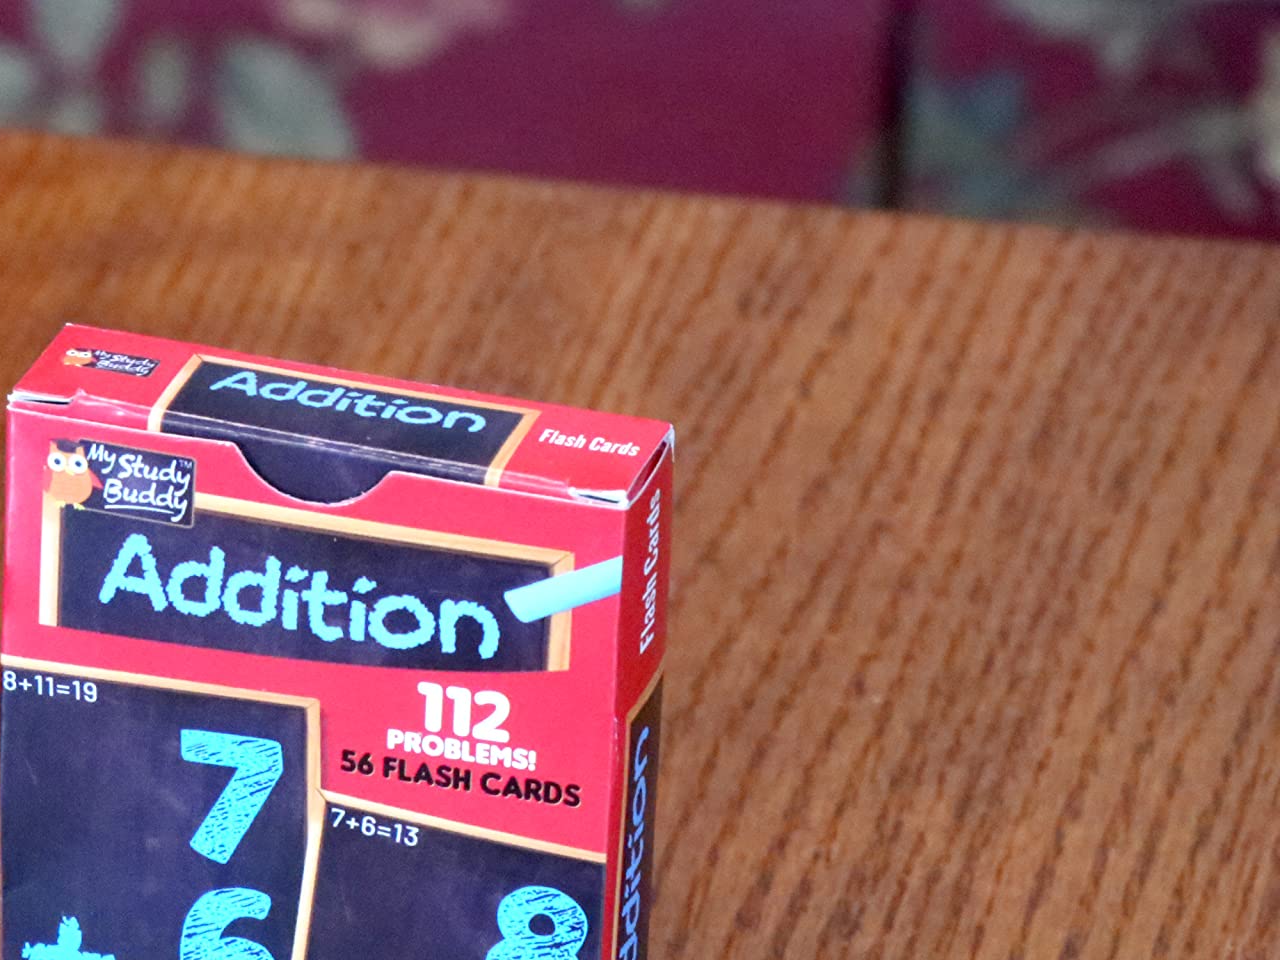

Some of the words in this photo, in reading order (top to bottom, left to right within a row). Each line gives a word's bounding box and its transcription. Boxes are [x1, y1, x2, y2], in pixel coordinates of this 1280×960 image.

[209, 370, 487, 433] Addition
[86, 443, 117, 474] My
[118, 454, 191, 497] Study
[538, 428, 587, 449] Flash
[588, 437, 640, 457] Cards
[102, 478, 188, 523] Buddy
[643, 488, 661, 576] Cards
[98, 532, 501, 660] Addition
[639, 572, 657, 655] Flash
[3, 669, 98, 703] 8+11=19
[416, 681, 511, 744] 112
[340, 748, 375, 777] 56
[382, 756, 472, 792] FLASH
[479, 771, 581, 808] CARDS
[386, 728, 537, 771] PROBLEMS!
[180, 728, 284, 864] 7
[330, 807, 420, 847] 7+6=13
